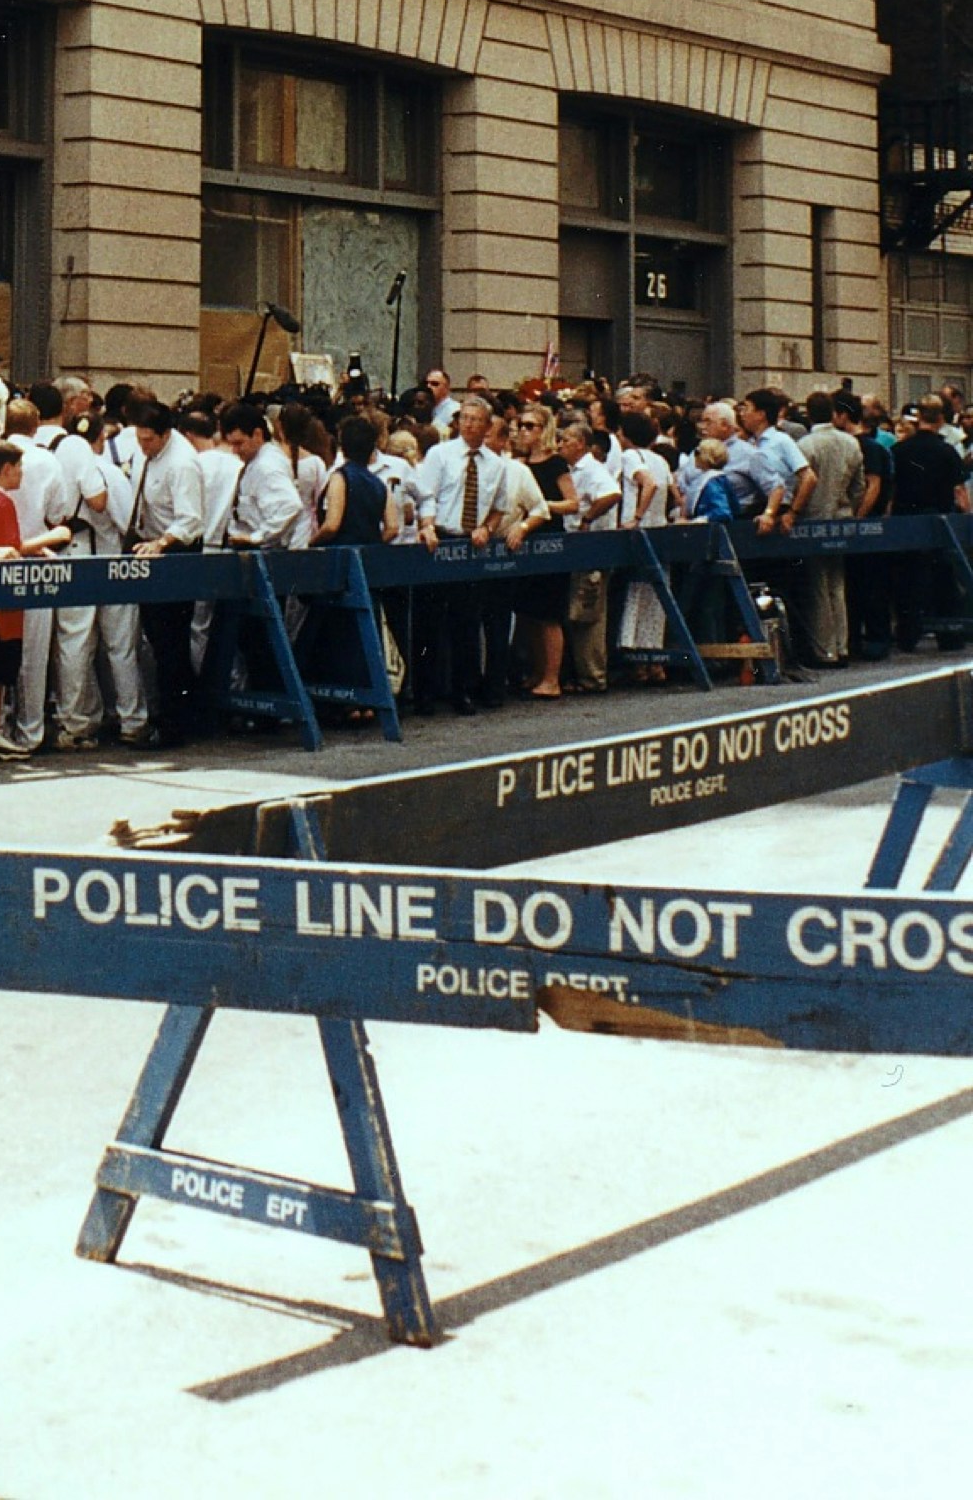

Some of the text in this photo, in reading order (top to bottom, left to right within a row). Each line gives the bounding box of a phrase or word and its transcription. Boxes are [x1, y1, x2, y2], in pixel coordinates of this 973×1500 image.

[646, 271, 667, 299] 26
[108, 560, 151, 580] ROSS
[607, 740, 662, 786] LINE
[672, 732, 708, 775] DO
[718, 721, 766, 764] NOT
[775, 704, 851, 753] CROSS
[650, 774, 727, 807] POLICE DEPT.
[32, 867, 261, 933] POLICE
[295, 880, 438, 942] LINE
[473, 888, 573, 951] DO
[608, 897, 753, 960] NOT
[416, 964, 531, 999] POLICE
[171, 1167, 245, 1210] POLICE
